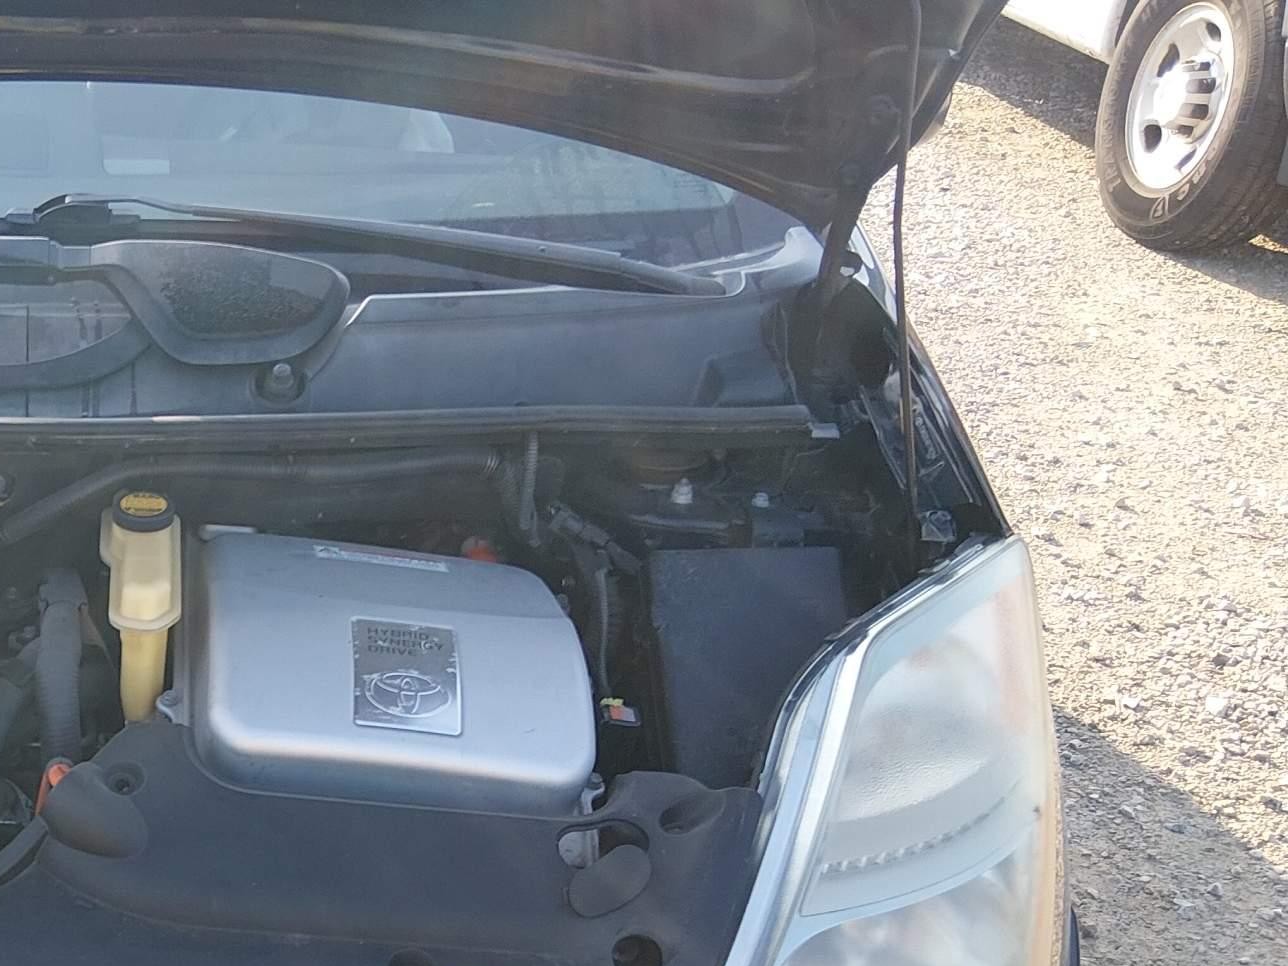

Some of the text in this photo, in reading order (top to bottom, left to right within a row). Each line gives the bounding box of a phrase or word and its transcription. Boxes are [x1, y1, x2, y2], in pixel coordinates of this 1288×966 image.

[367, 627, 429, 640] HYBRID
[367, 635, 444, 650] SYNERGY
[367, 645, 418, 656] DRIVE
